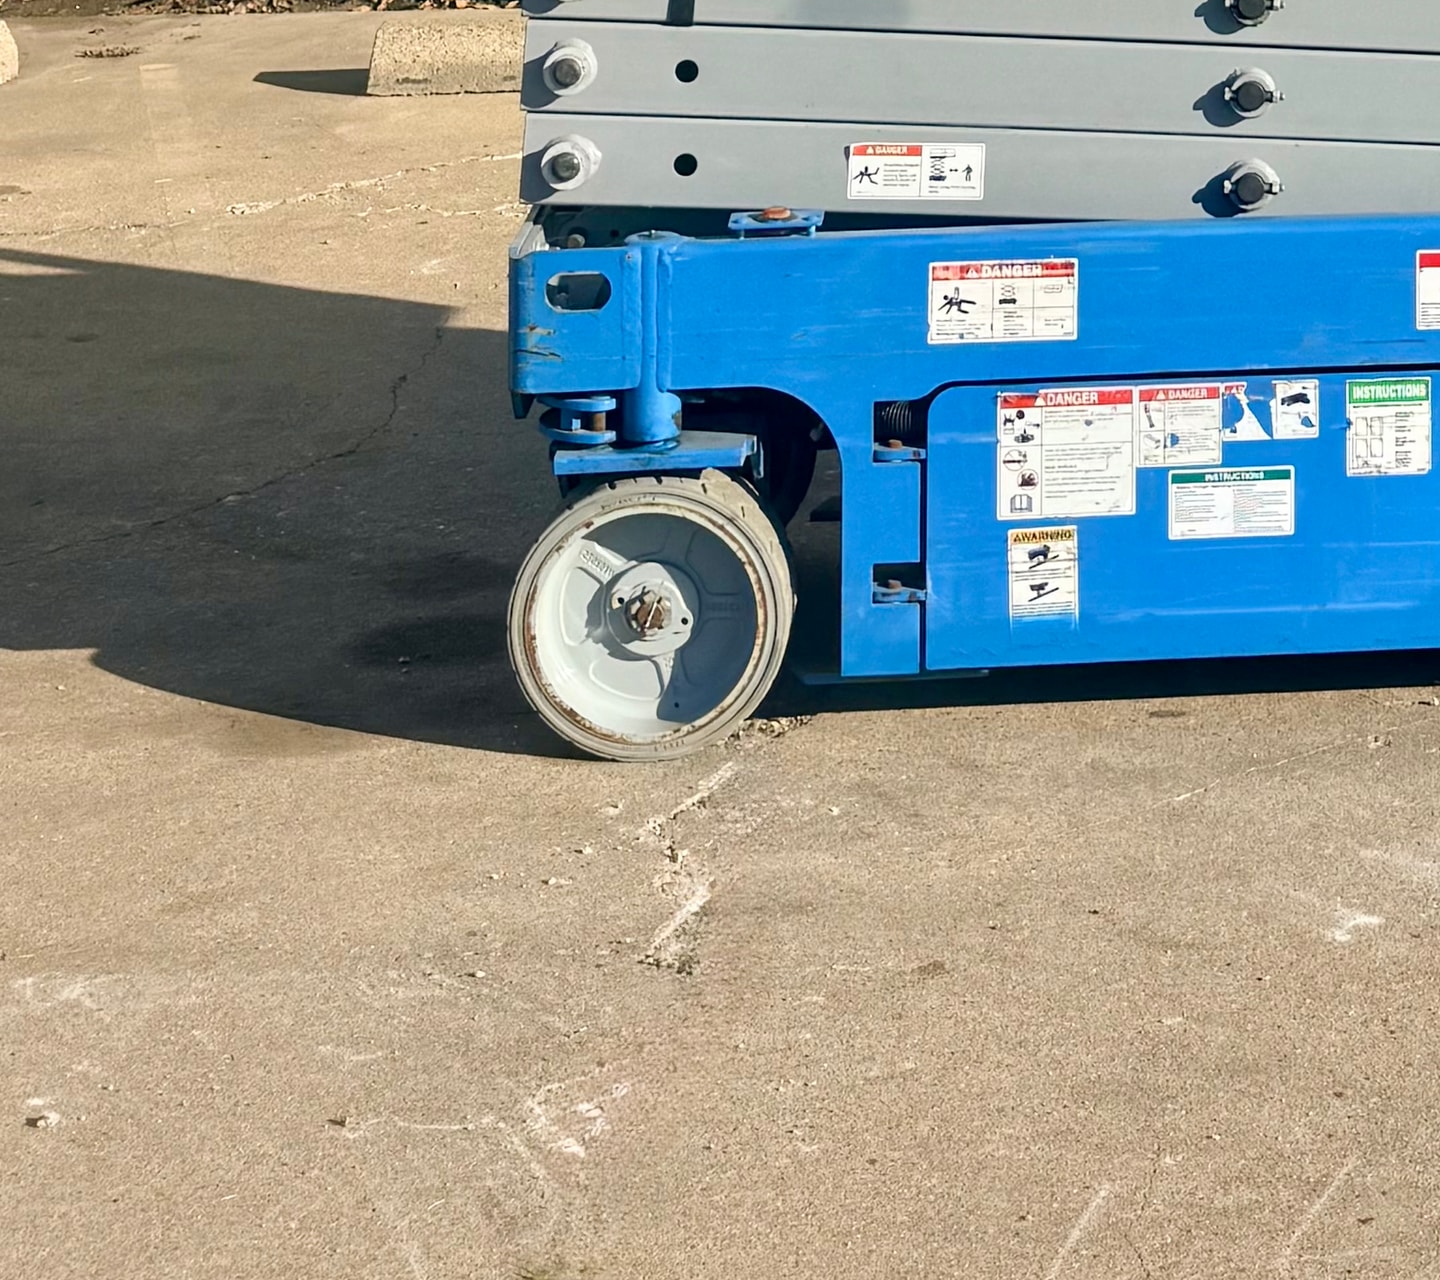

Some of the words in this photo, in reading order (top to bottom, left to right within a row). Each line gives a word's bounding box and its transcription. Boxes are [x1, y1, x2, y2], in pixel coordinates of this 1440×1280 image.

[982, 263, 1042, 278] DANGER
[1168, 389, 1208, 399] DANGER
[1353, 383, 1426, 399] INSTRUCTIONS
[1046, 392, 1099, 406] DANGER
[1021, 529, 1072, 542] WARNING
